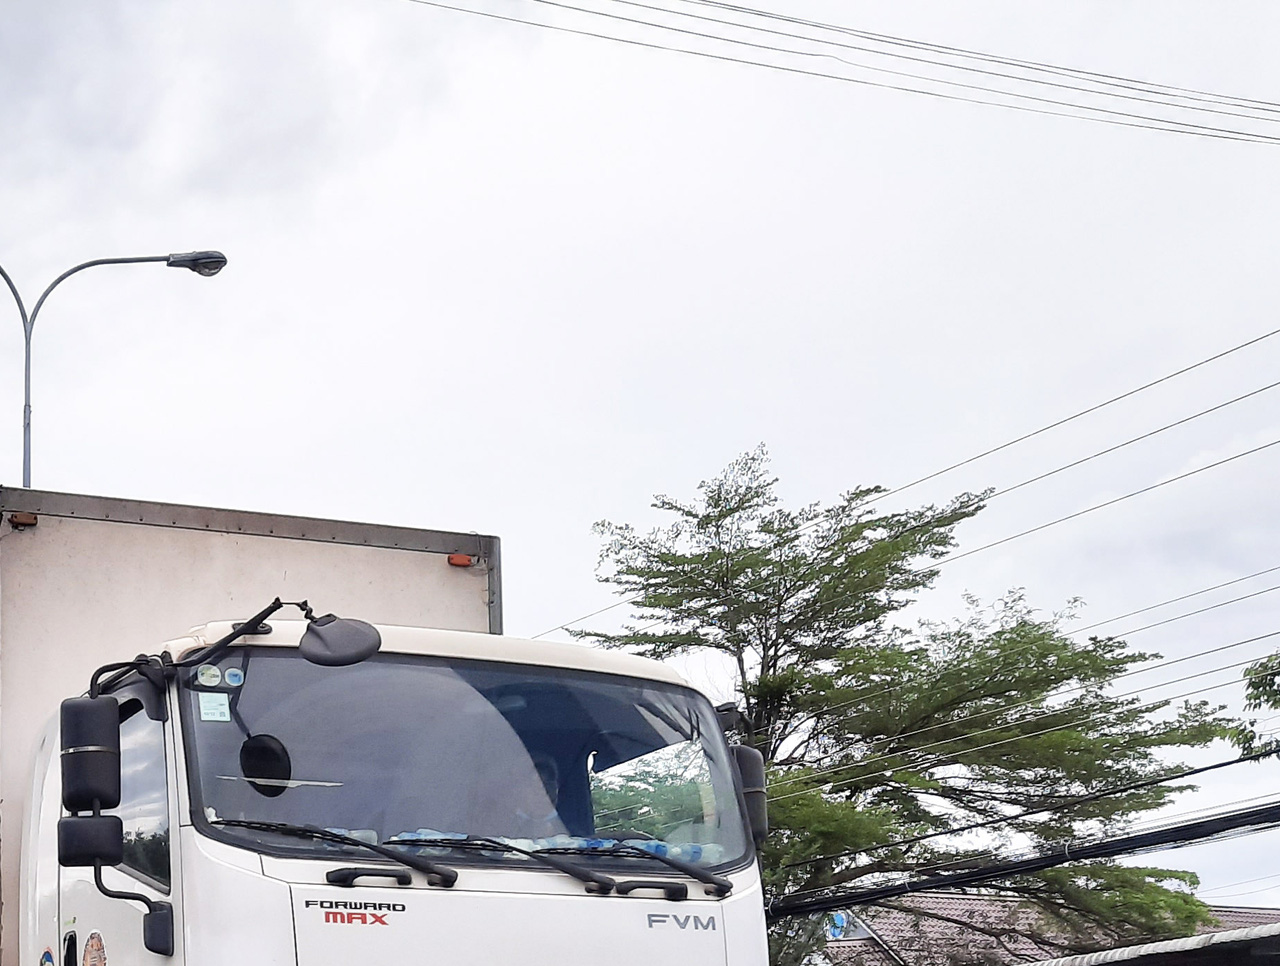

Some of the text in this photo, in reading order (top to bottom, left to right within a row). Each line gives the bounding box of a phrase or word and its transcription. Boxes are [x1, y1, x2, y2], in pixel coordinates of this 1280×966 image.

[305, 900, 406, 911] FORWARD
[324, 911, 389, 925] MAX
[647, 913, 716, 930] FVM
